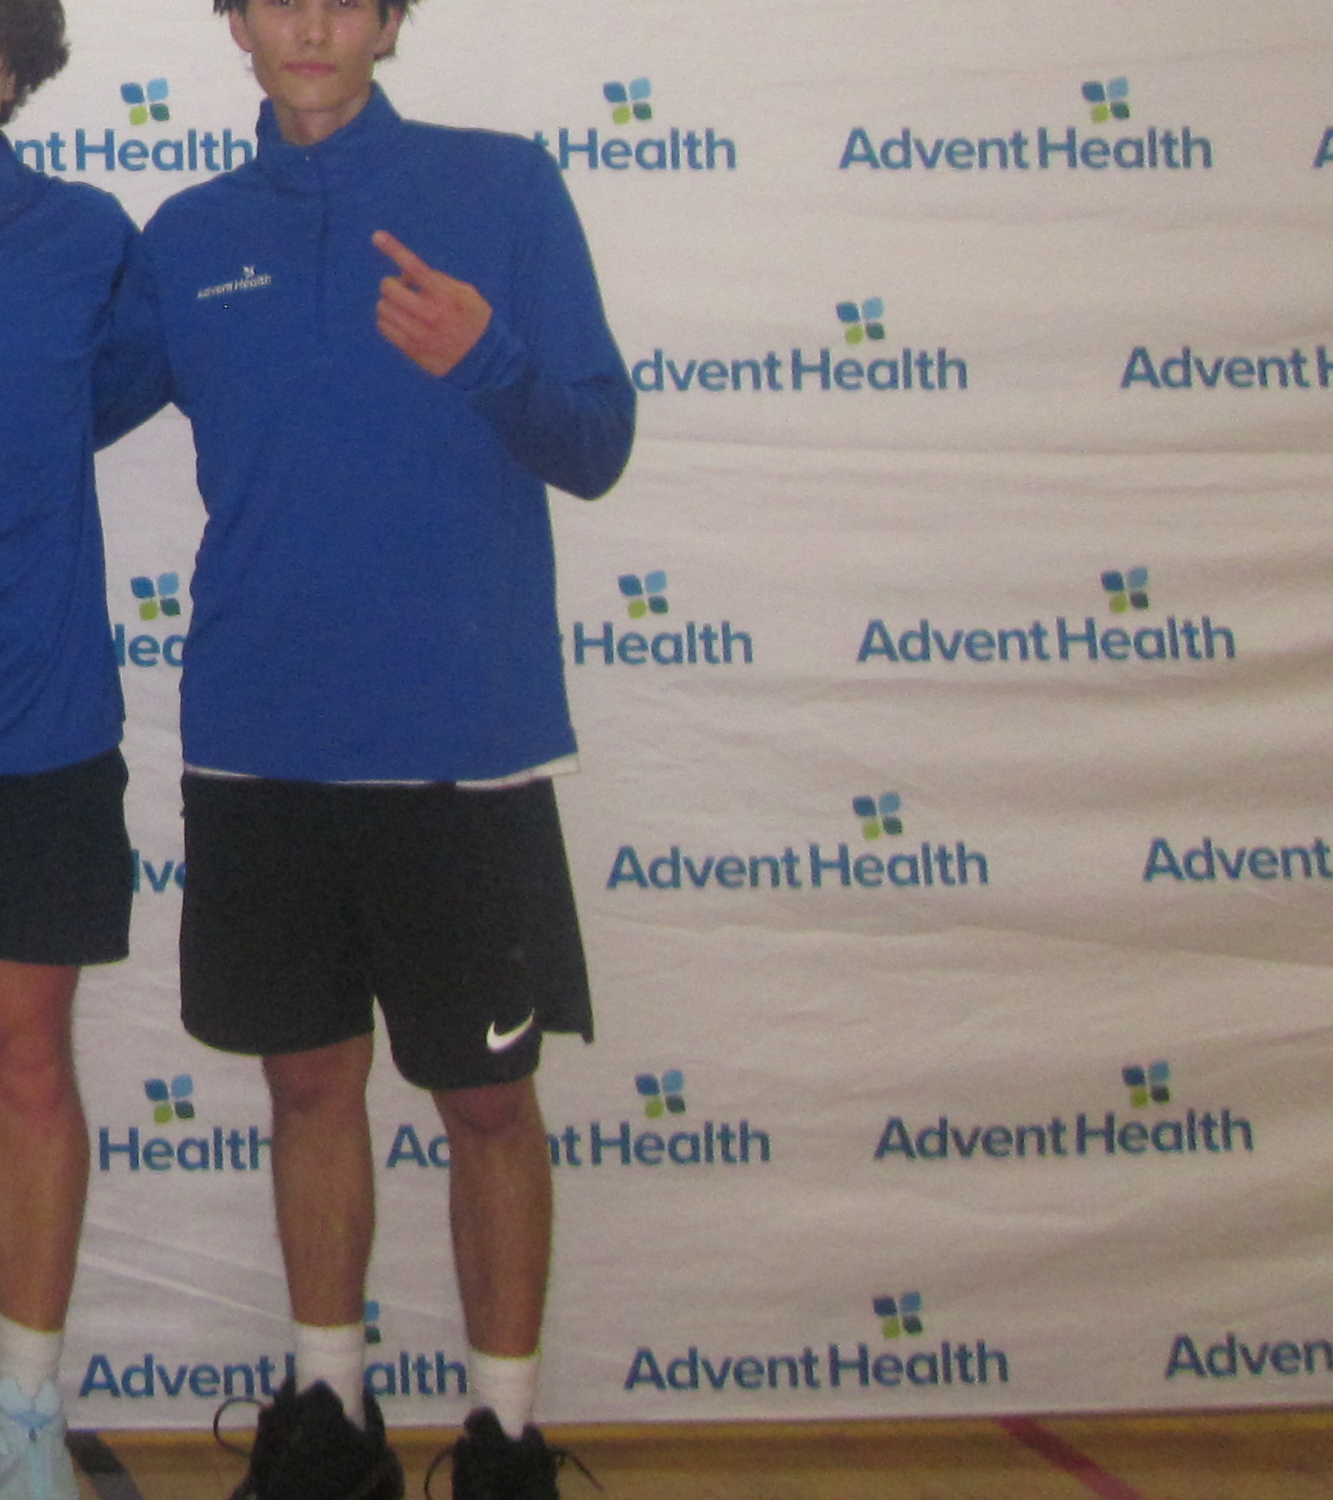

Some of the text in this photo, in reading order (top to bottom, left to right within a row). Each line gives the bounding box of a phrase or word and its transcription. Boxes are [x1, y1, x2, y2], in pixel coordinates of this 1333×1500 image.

[13, 127, 255, 172] ntHealth
[534, 126, 737, 171] Health
[837, 125, 1215, 172] AdventHealth
[632, 347, 969, 392] dventHealth
[572, 619, 754, 667] Health
[855, 615, 1237, 664] AdventHealth
[605, 840, 990, 891] AdventHealth
[1141, 835, 1333, 884] Advent
[874, 1108, 1255, 1161] AdventHealth
[623, 1340, 1011, 1392] AdventHealth
